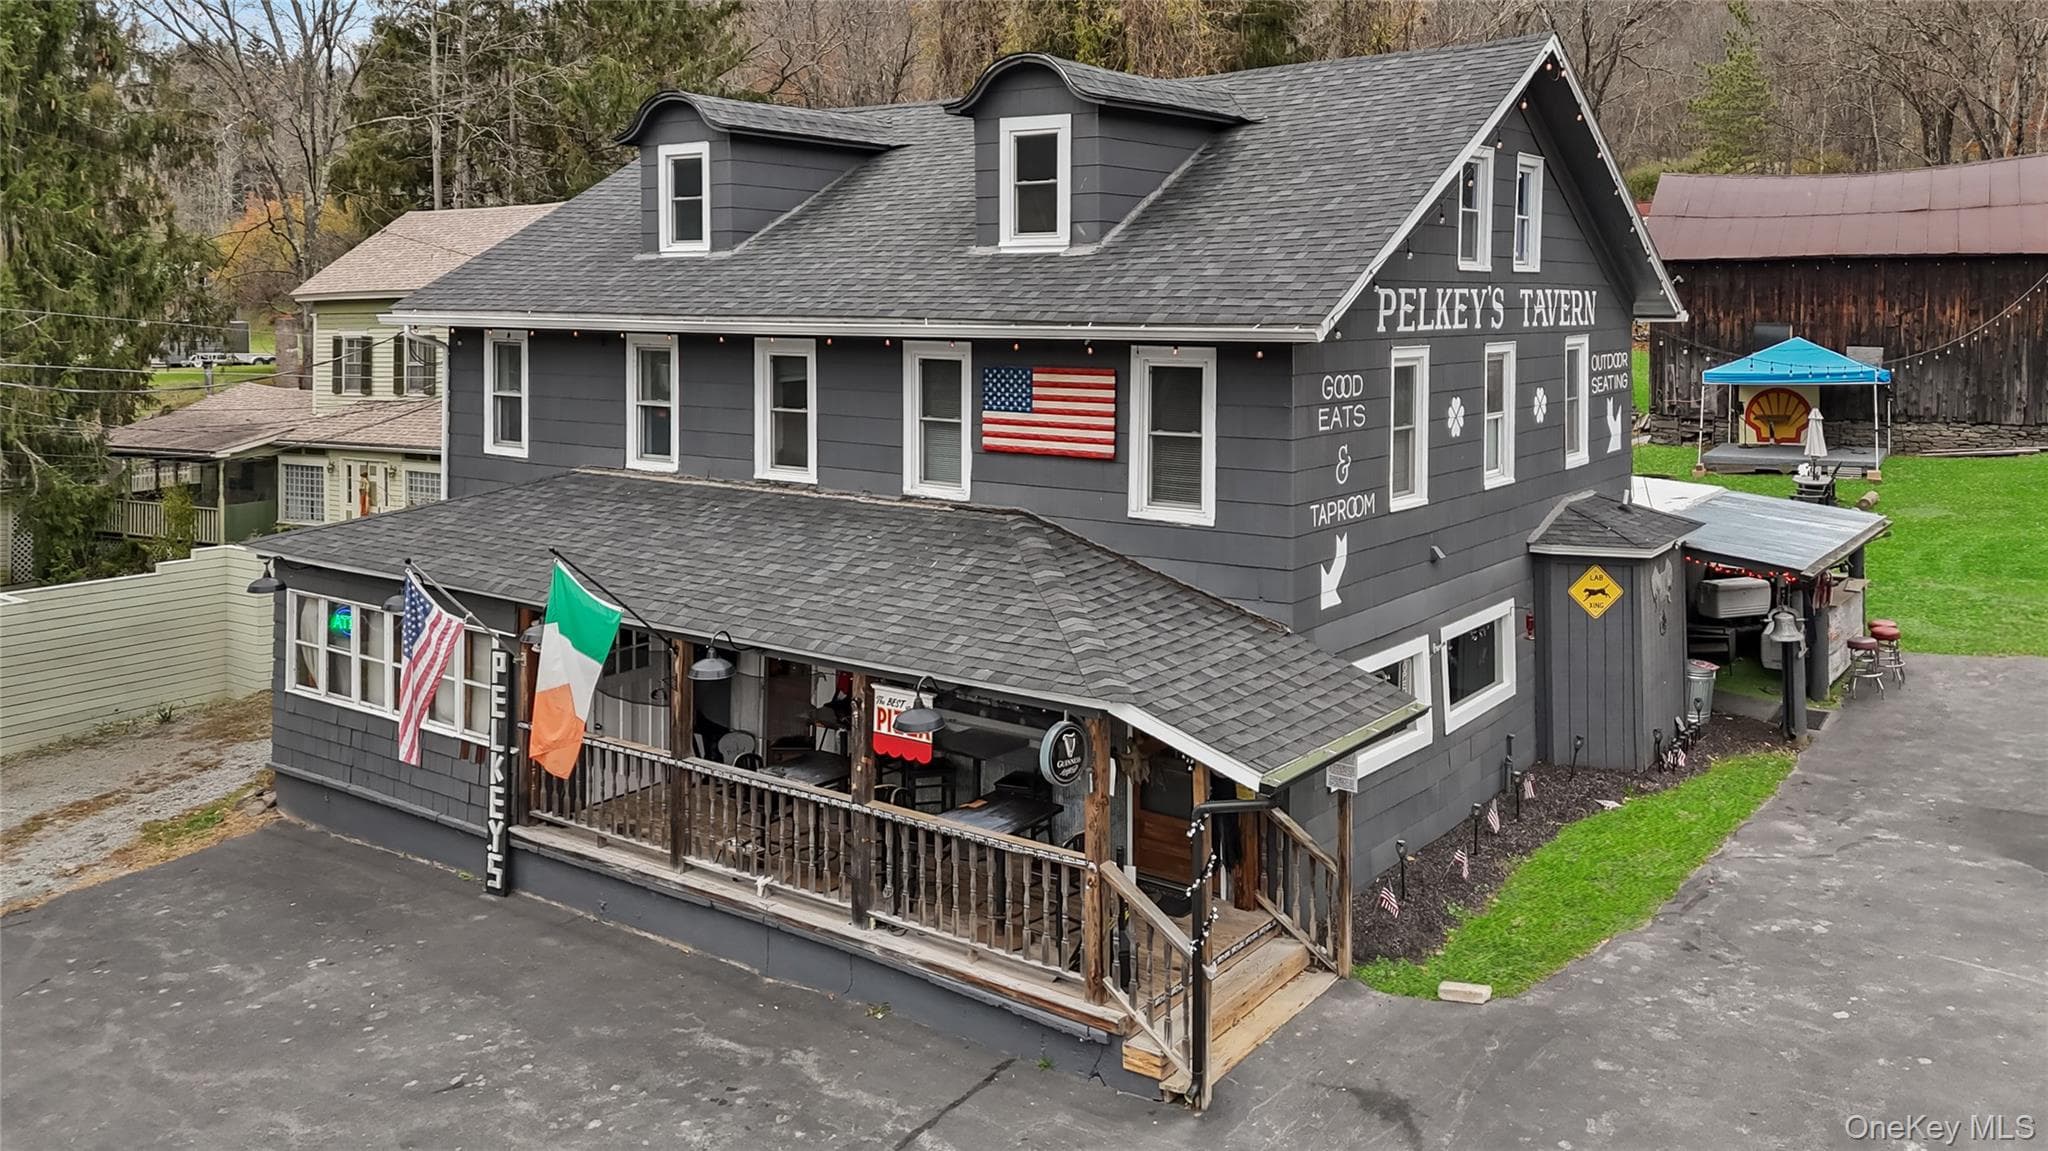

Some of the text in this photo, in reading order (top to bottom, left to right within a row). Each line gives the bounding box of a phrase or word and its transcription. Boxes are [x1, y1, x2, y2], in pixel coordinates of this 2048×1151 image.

[1377, 285, 1598, 332] PELKEY'S TAVERN
[1591, 352, 1629, 371] OUTDOOR
[1321, 374, 1364, 400] GOOD
[1591, 372, 1629, 394] SEATING
[1318, 404, 1366, 431] EATS
[1335, 444, 1352, 485] &
[1309, 492, 1376, 528] TAPROOM
[886, 697, 906, 708] BEST
